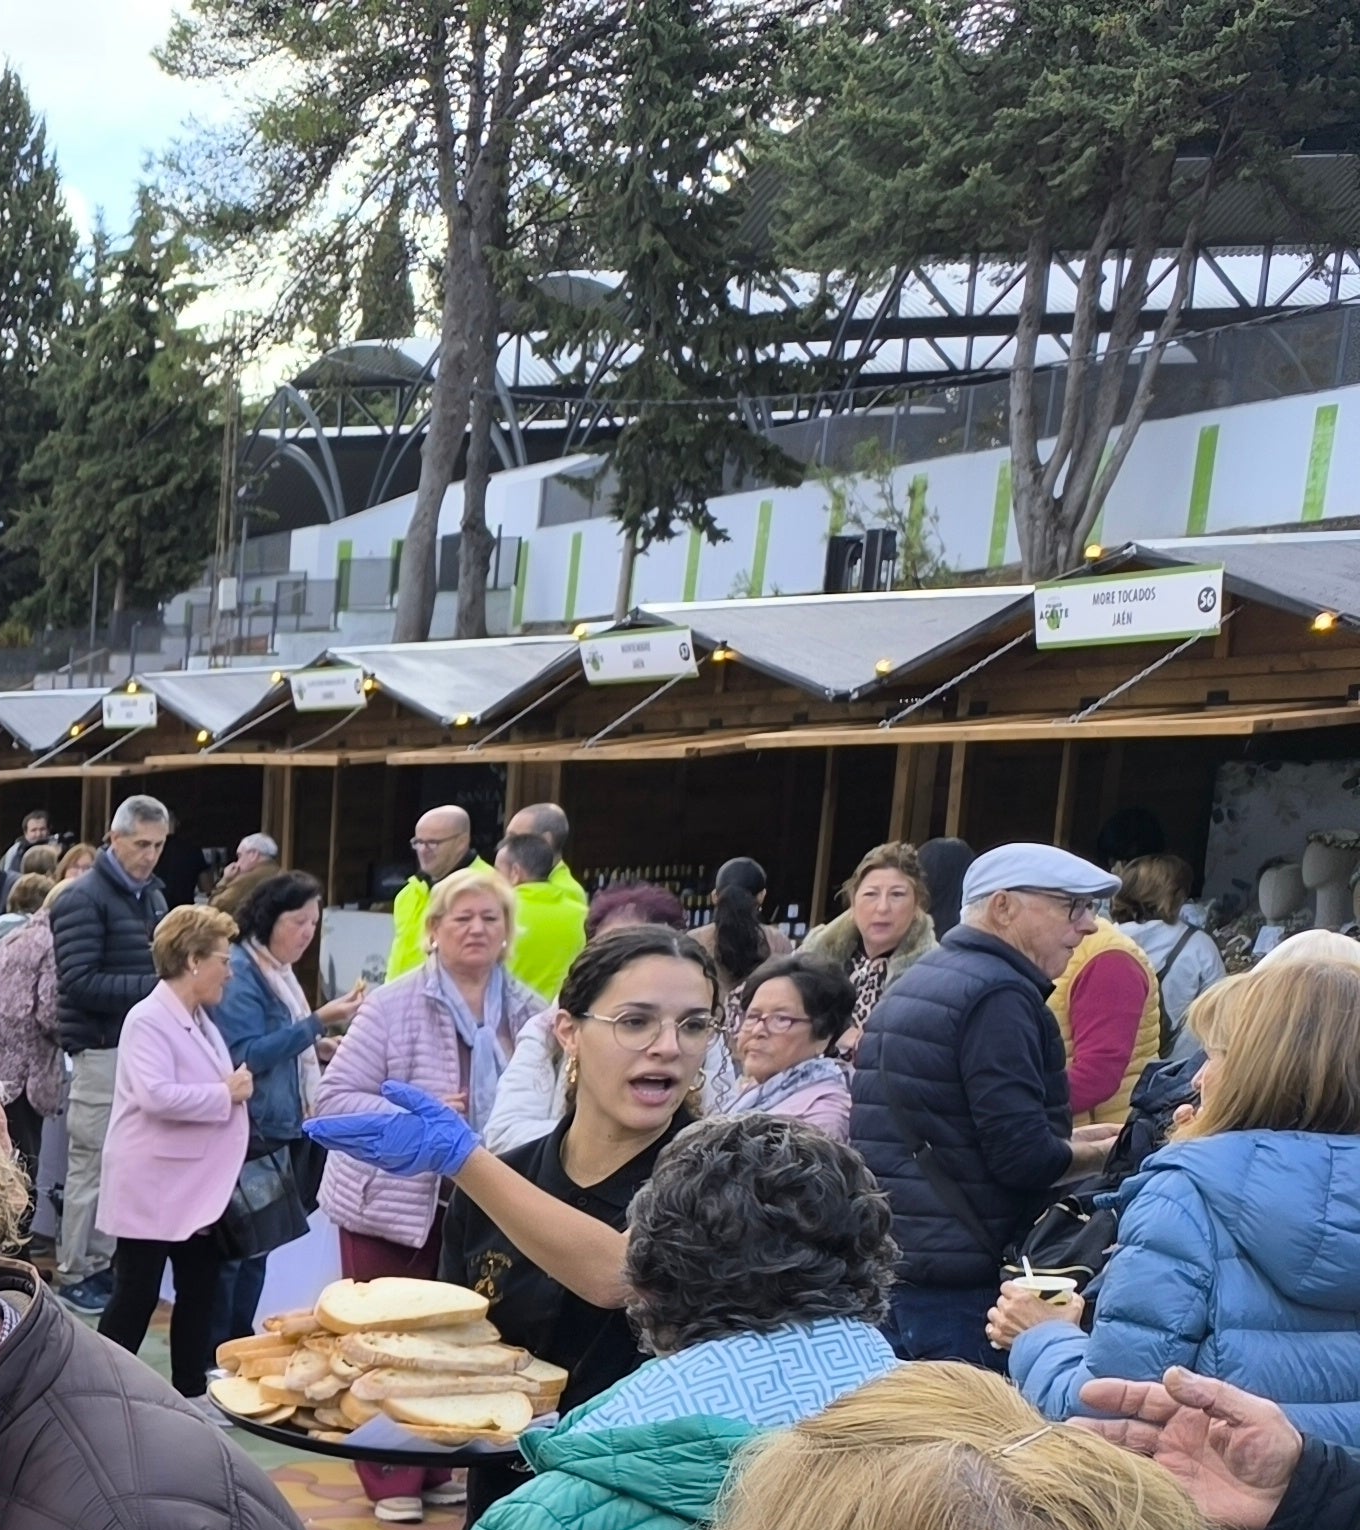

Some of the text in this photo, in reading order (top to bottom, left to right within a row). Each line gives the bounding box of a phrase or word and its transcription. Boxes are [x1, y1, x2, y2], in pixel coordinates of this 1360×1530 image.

[1092, 587, 1157, 606] MORE TOCADOS
[1112, 611, 1133, 627] JAÉN
